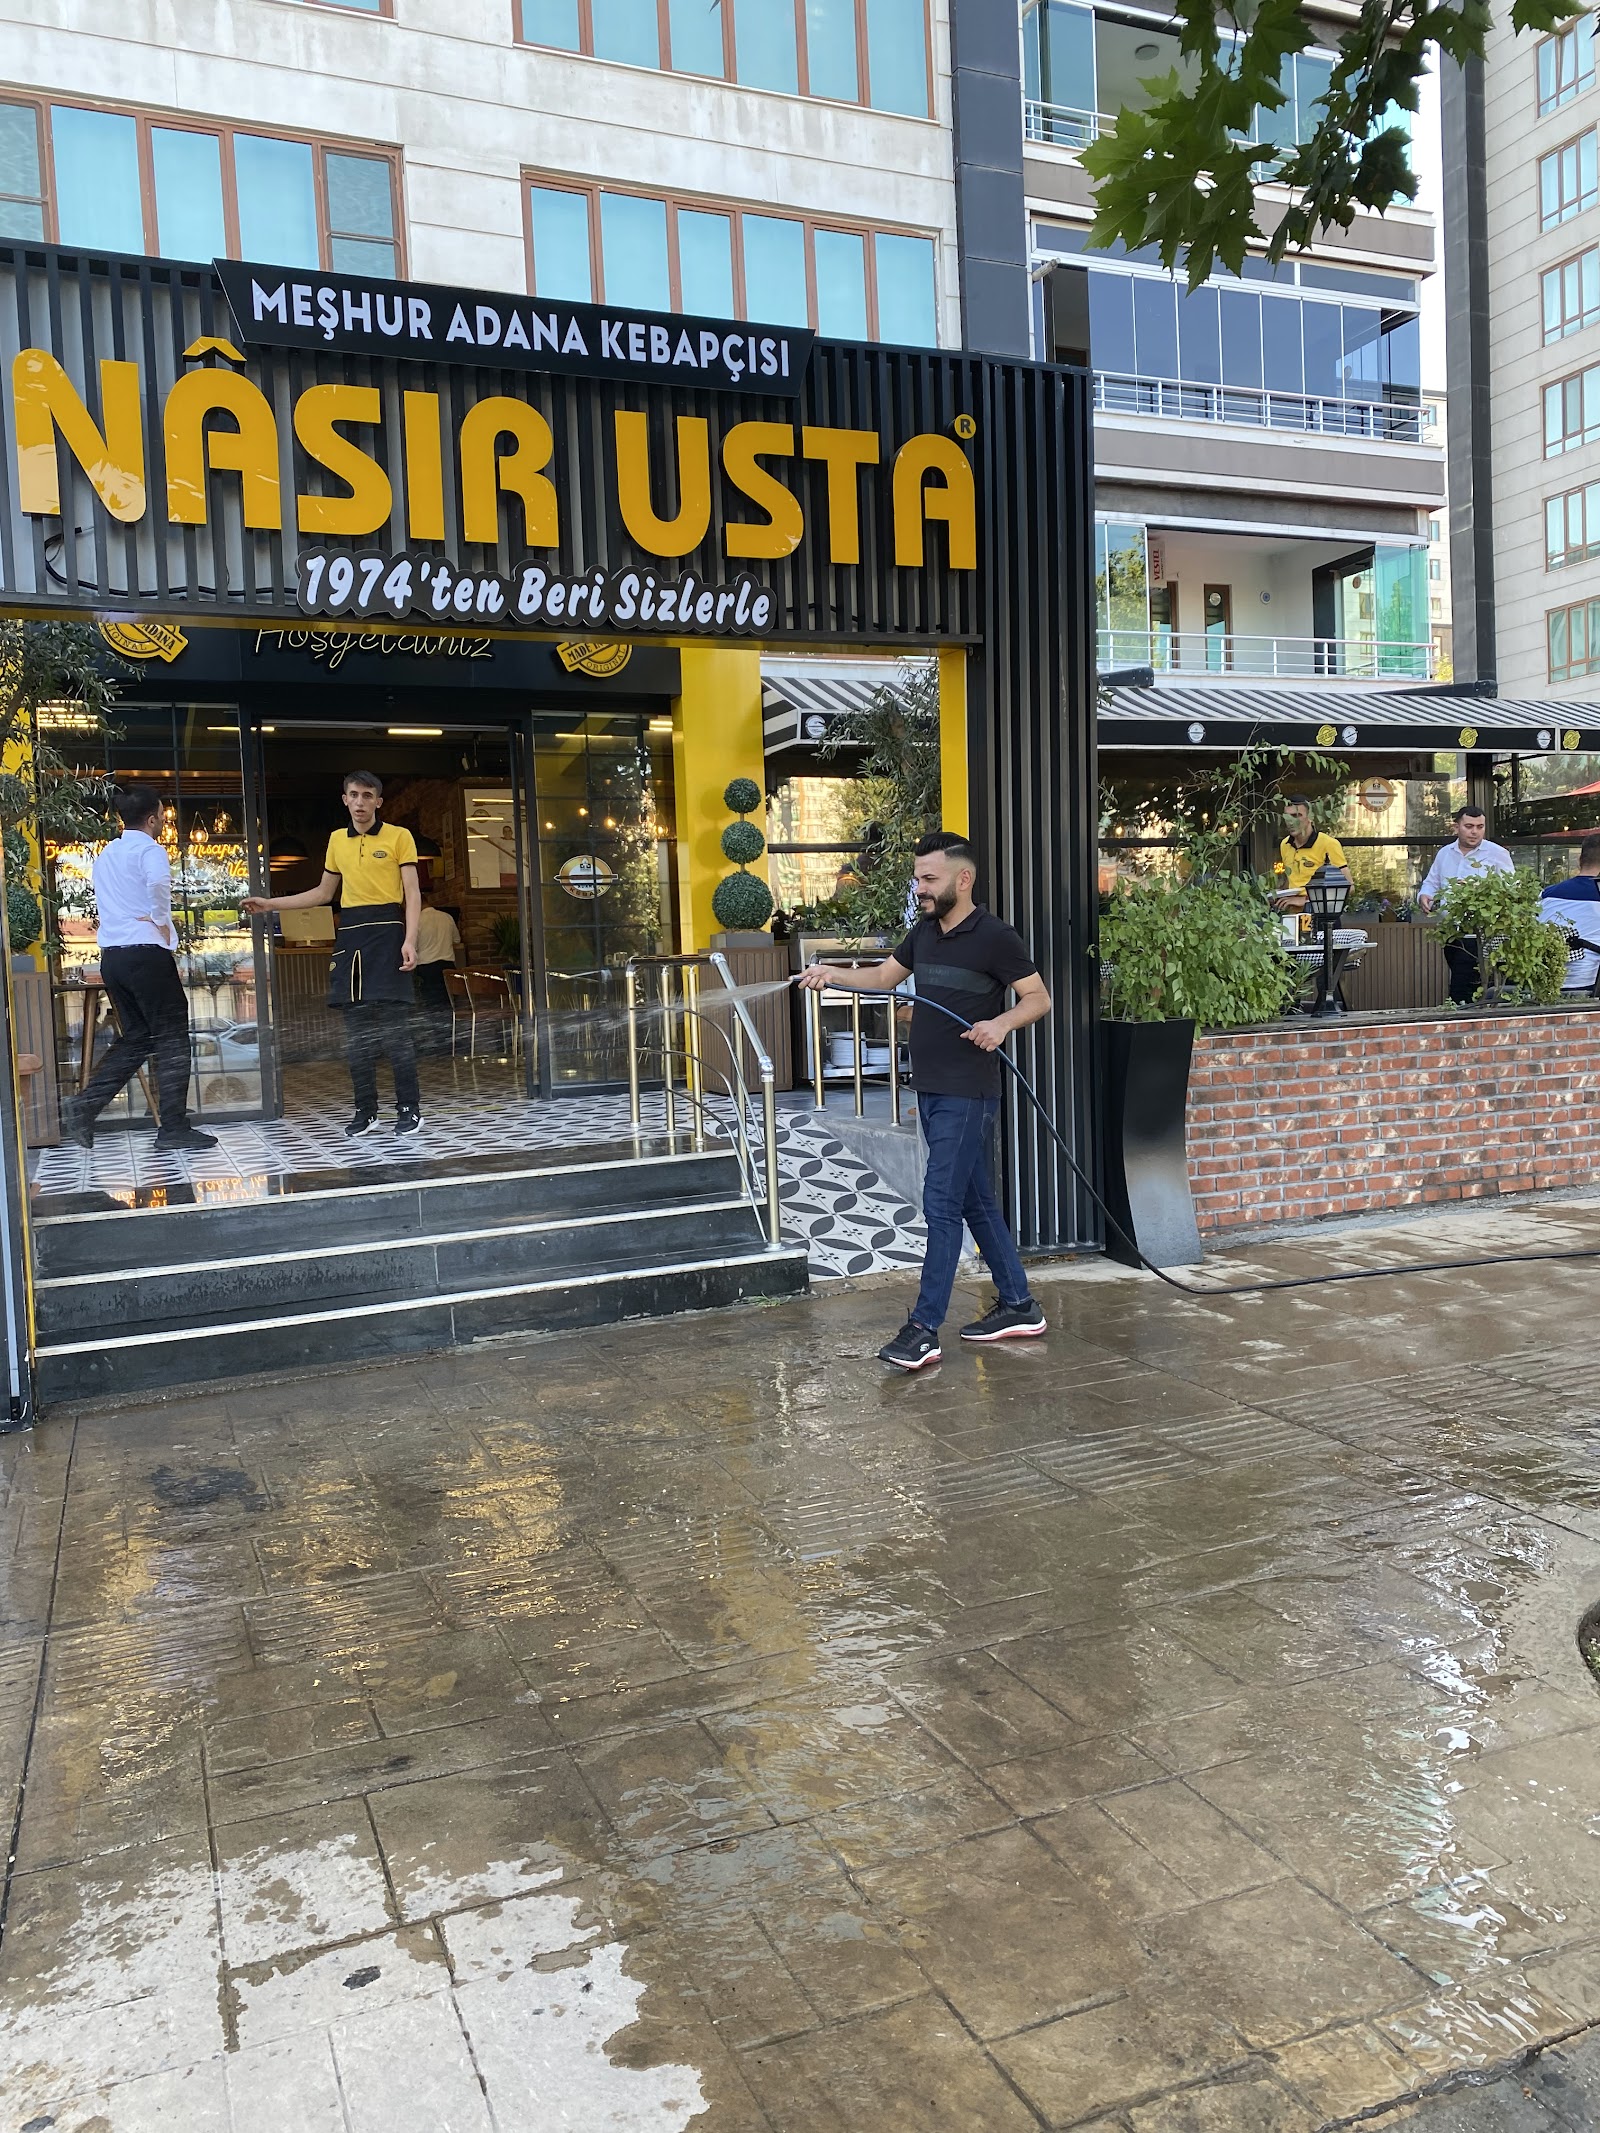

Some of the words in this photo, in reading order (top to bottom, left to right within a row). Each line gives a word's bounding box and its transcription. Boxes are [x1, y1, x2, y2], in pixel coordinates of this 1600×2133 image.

[251, 278, 433, 341] MEŞHUR
[445, 302, 589, 356] ADANA
[600, 319, 790, 382] KEBAPÇISI
[12, 336, 560, 549] NÂSIR
[614, 410, 977, 571] USTA
[306, 555, 504, 613] 1974'ten
[517, 567, 605, 618] Beri
[614, 573, 771, 627] Sizlerle
[567, 643, 592, 662] MADE
[586, 647, 626, 671] ORIGINAL
[227, 859, 249, 877] Va
